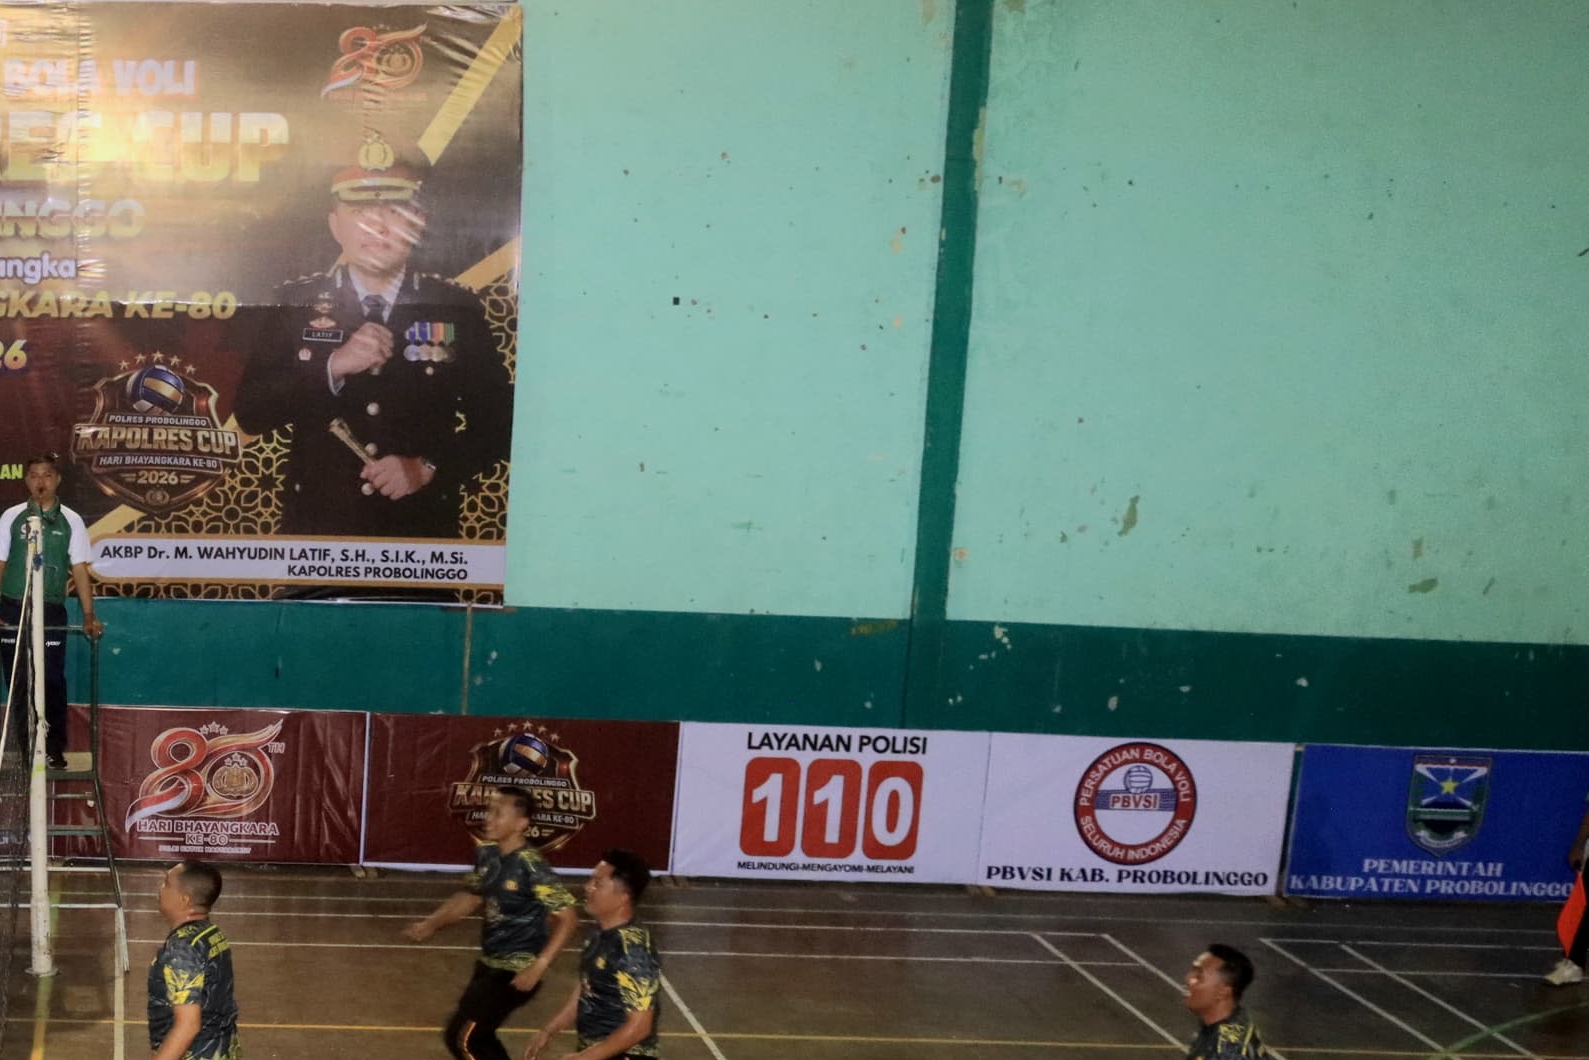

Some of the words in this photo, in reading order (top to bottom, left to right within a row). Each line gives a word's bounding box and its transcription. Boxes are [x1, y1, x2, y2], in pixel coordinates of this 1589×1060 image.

[3, 59, 100, 97] BOLA
[113, 59, 197, 97] VOLI
[124, 291, 237, 320] KE-80
[109, 415, 143, 424] POLRES
[76, 426, 193, 452] KAPOLRES
[196, 430, 237, 454] CUP
[99, 456, 122, 465] HARI
[124, 456, 192, 466] BHAYANGKARA
[137, 470, 178, 484] 2026
[100, 545, 143, 560] AKBP
[147, 545, 170, 560] Dr.
[175, 546, 193, 560] M.
[197, 545, 285, 561] WAHYUDIN
[289, 547, 336, 564] LATIF,
[340, 548, 374, 565] S.H.,
[380, 549, 425, 566] S.I.K.,
[430, 550, 468, 566] M.Si.
[287, 563, 360, 578] KAPOLRES
[364, 565, 468, 580] PROBOLINGGO
[268, 742, 285, 753] TH
[747, 732, 852, 752] LAYANAN
[859, 735, 928, 755] POLISI
[1079, 748, 1139, 806] PERSATUAN
[1143, 748, 1177, 772] BOLA
[1175, 770, 1190, 802] VOLI
[557, 791, 592, 812] CUP
[752, 773, 914, 847] 110
[1110, 793, 1159, 809] PBVSI
[137, 819, 172, 832] HARI
[174, 820, 279, 835] BHAYANGKARA
[185, 834, 229, 846] KE-80
[1080, 815, 1125, 860] SELURUH
[1127, 818, 1187, 861] INDONESIA
[986, 865, 1052, 881] PBVSI
[1059, 867, 1109, 883] KAB.
[1116, 868, 1268, 887] PROBOLINGGO
[1362, 858, 1504, 877] PEMERINTAH
[1290, 875, 1423, 893] KABUPATEN
[1425, 876, 1574, 897] PROBOLINGGO
